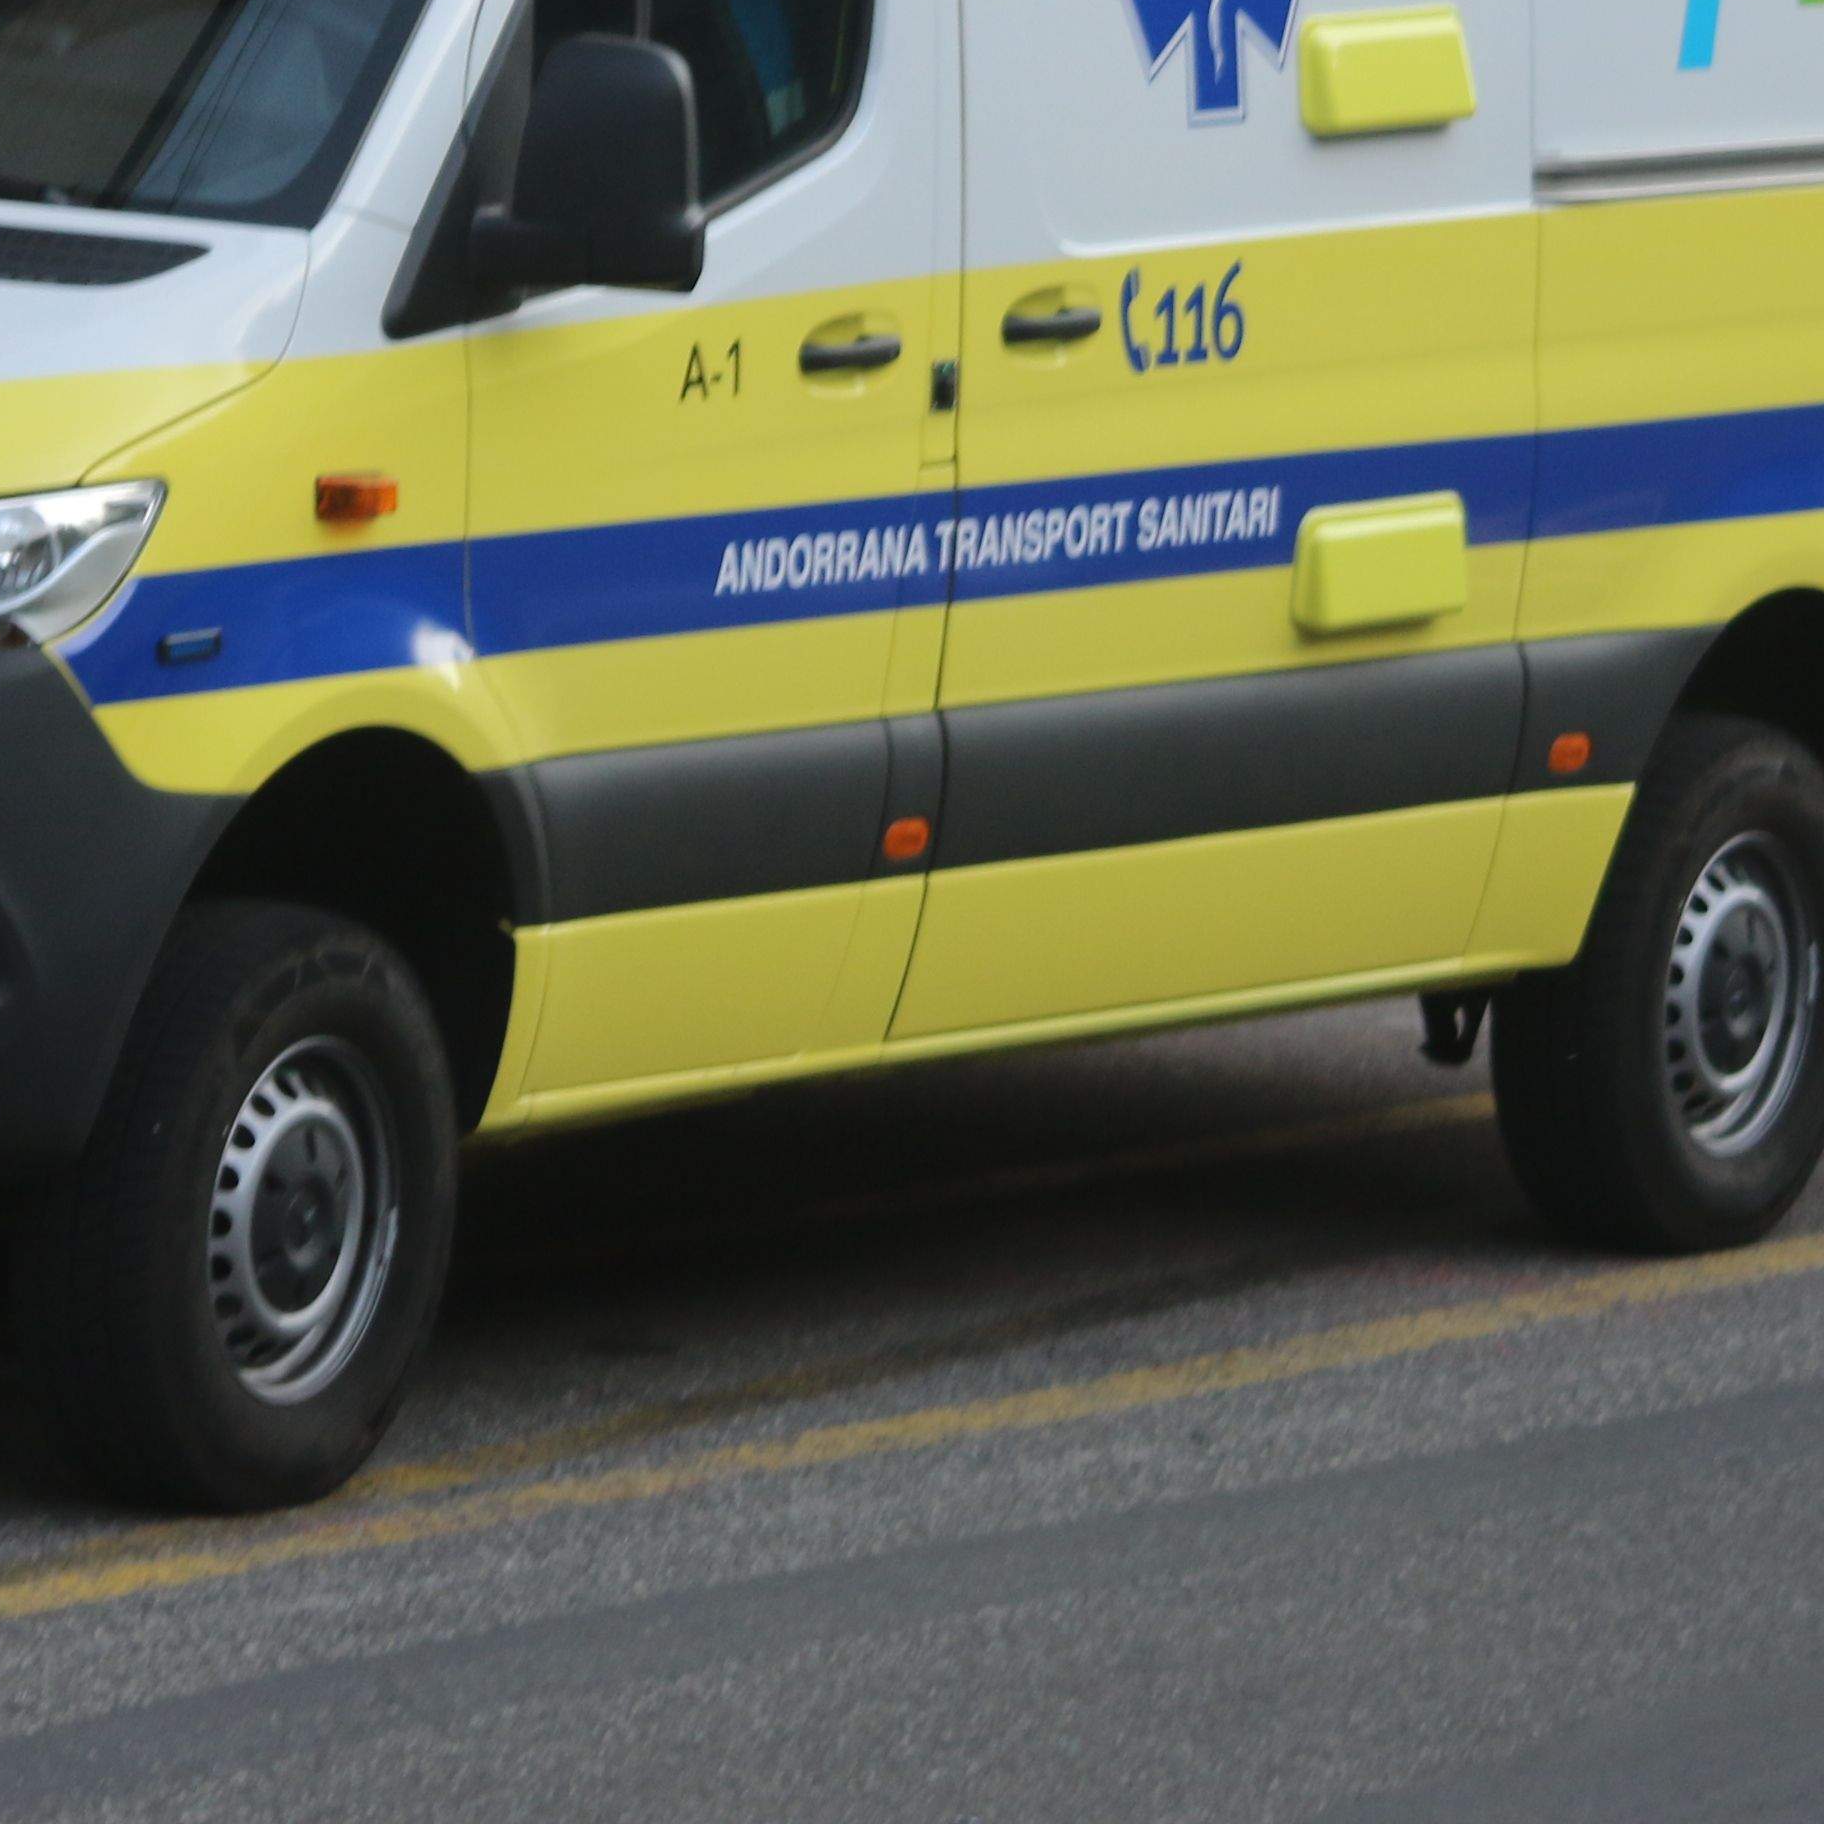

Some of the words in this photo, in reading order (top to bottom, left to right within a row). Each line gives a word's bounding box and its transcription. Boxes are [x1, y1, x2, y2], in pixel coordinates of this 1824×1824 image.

[1152, 259, 1246, 366] 116
[678, 336, 744, 405] A-1
[713, 521, 930, 597] ANDORRANA
[933, 497, 1136, 574] TRANSPORT
[1137, 483, 1282, 554] SANITARI
